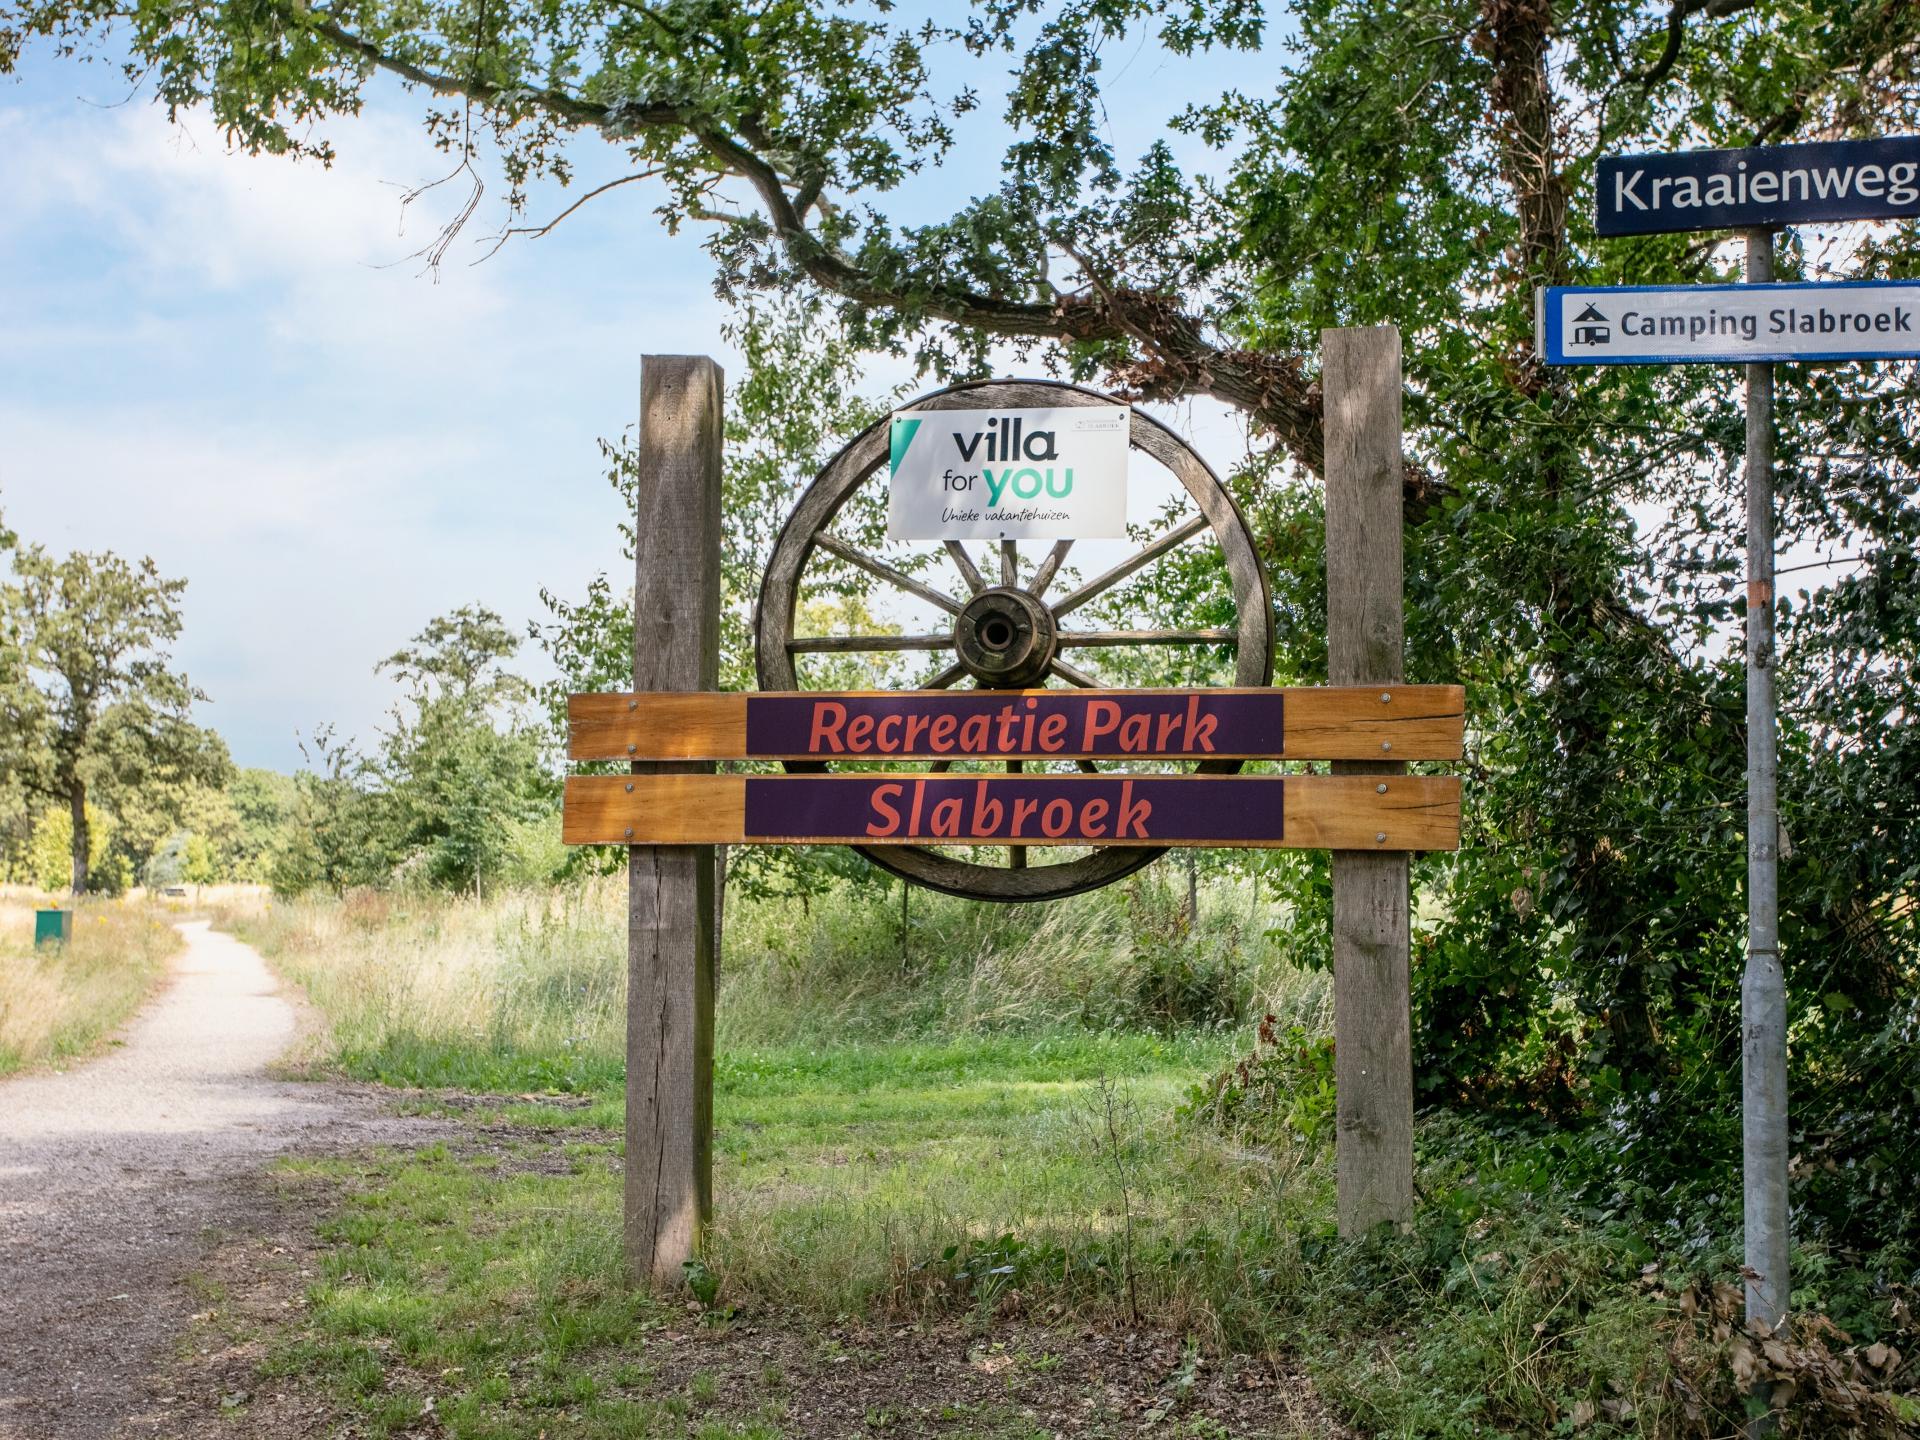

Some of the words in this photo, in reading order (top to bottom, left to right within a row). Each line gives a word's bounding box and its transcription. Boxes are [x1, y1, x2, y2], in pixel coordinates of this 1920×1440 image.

[1615, 161, 1919, 212] Kraaienweg
[1621, 309, 1757, 341] Camping
[1769, 307, 1912, 335] Slabroek
[953, 417, 1059, 462] villa
[942, 469, 978, 491] for
[982, 467, 1074, 508] you
[942, 507, 979, 523] Unieke
[985, 507, 1071, 523] vakantiehuizen
[808, 697, 1067, 753] Recreatie
[1081, 695, 1219, 753] Park
[866, 780, 1153, 838] Slabroek
